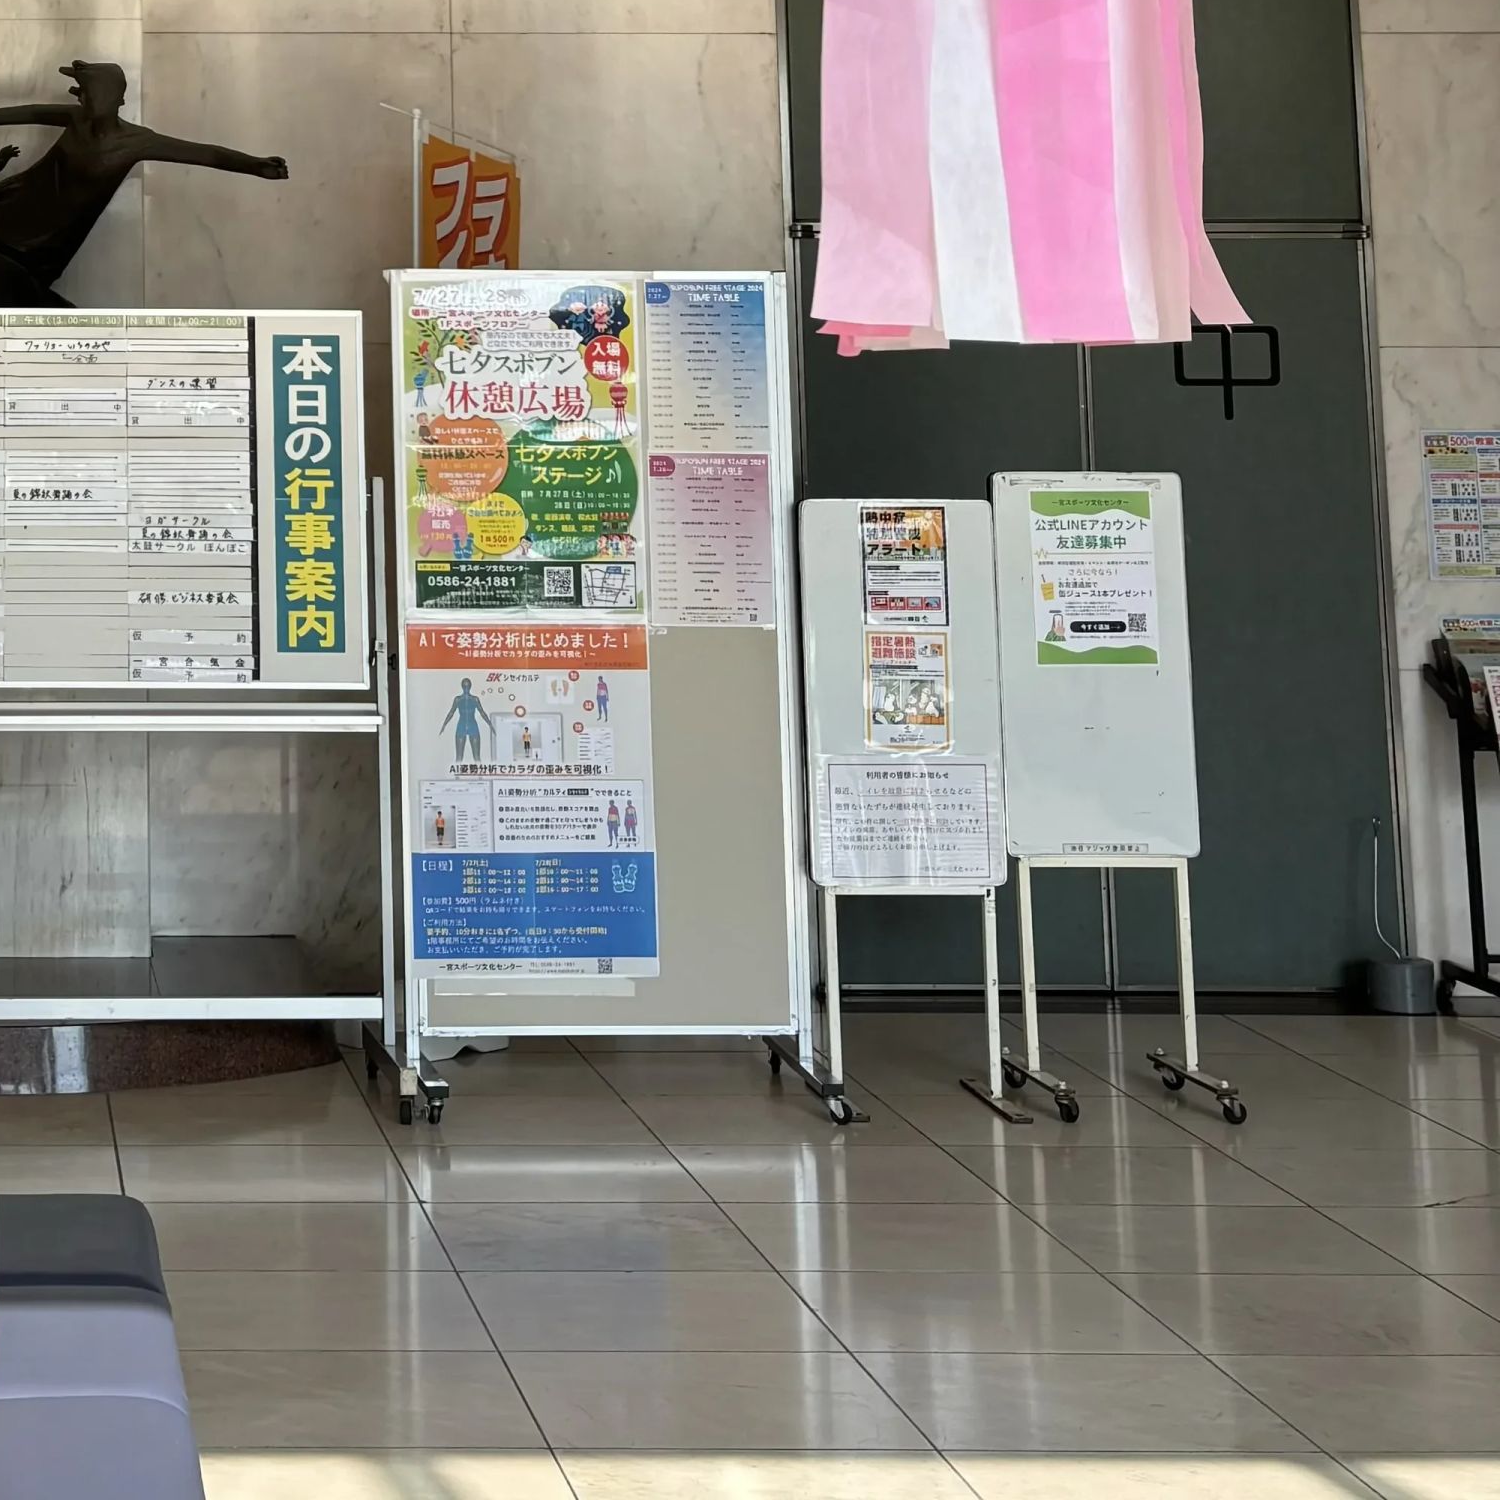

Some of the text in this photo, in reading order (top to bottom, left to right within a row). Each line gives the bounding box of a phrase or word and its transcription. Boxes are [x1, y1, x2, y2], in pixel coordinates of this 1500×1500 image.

[688, 293, 740, 302] TIME TABLE
[592, 342, 621, 357] 入場
[441, 351, 578, 376] 七夕スポブン
[592, 360, 621, 376] 無料
[445, 380, 585, 419] 休憩広場
[515, 443, 618, 462] 七夕スポブン
[281, 338, 337, 648] 本日の行事案内
[1035, 519, 1148, 531] 公式LINEアカウント
[866, 543, 921, 556] アラート
[1056, 535, 1127, 549] 友達募集中
[427, 576, 517, 587] 0586-24-1881
[418, 631, 630, 649] AIで姿勢分析はじめました！
[449, 764, 610, 775] AI姿勢分析でカラダの歪みを可視化！
